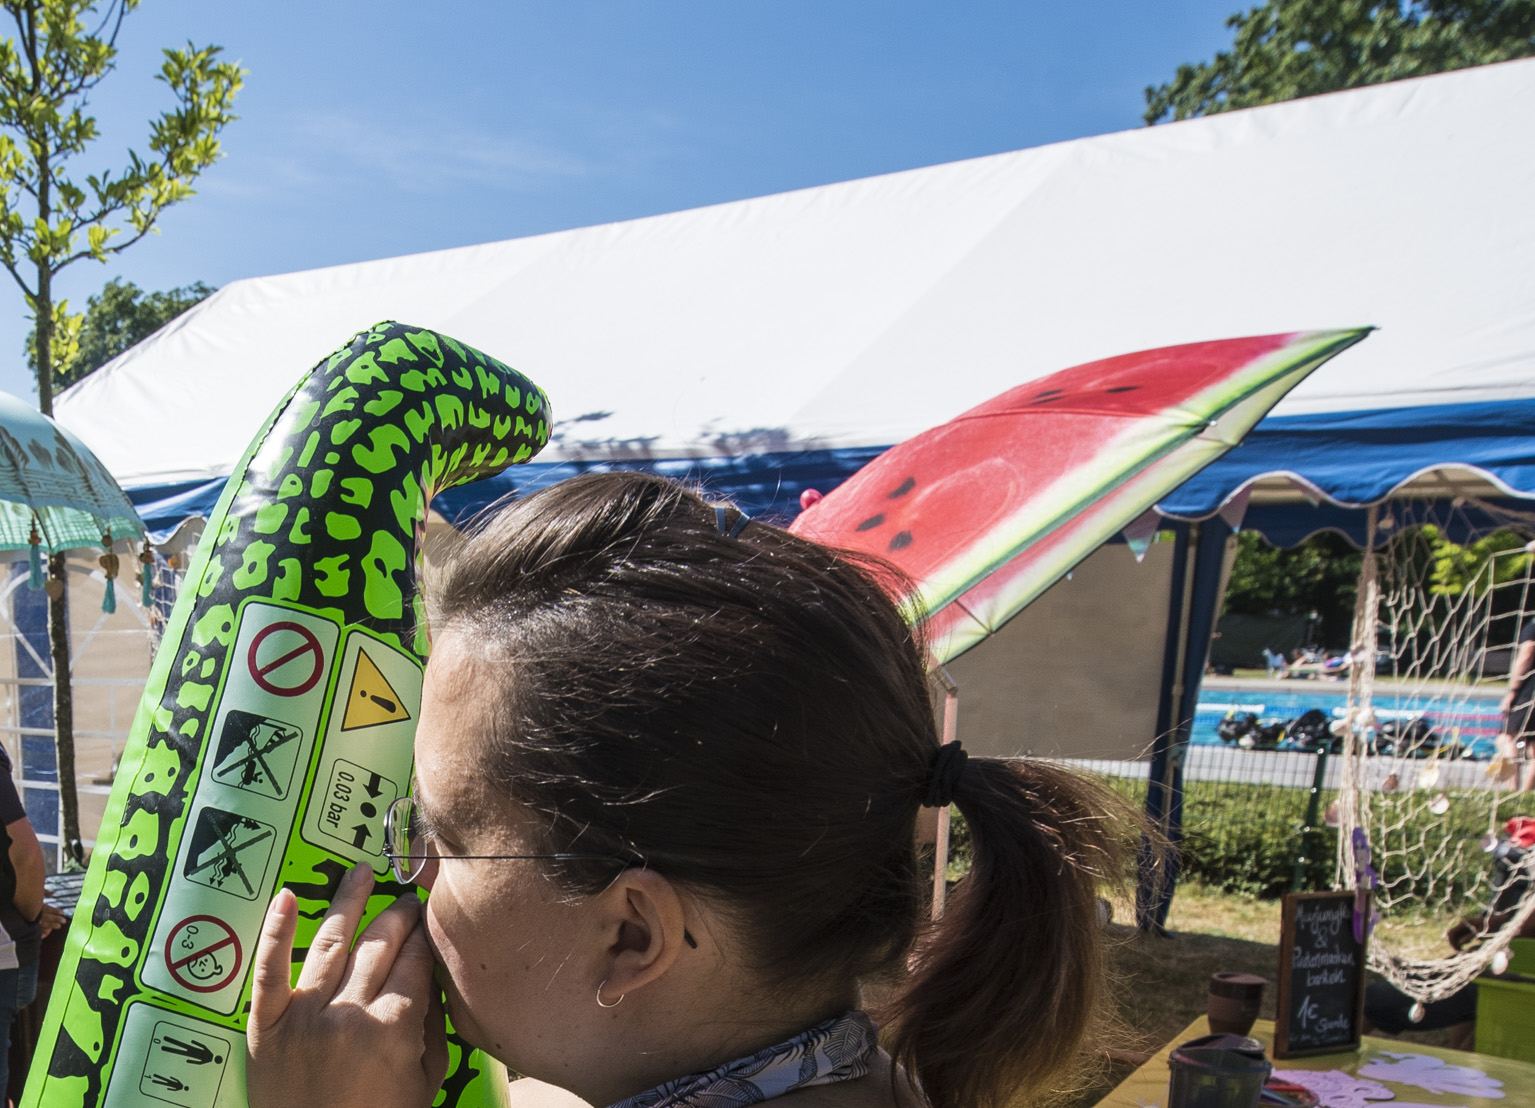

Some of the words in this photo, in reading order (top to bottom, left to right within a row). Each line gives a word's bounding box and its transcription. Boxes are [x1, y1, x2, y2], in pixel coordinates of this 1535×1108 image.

[333, 771, 355, 802] 0.03
[326, 802, 348, 829] bar
[181, 925, 199, 950] 0-3
